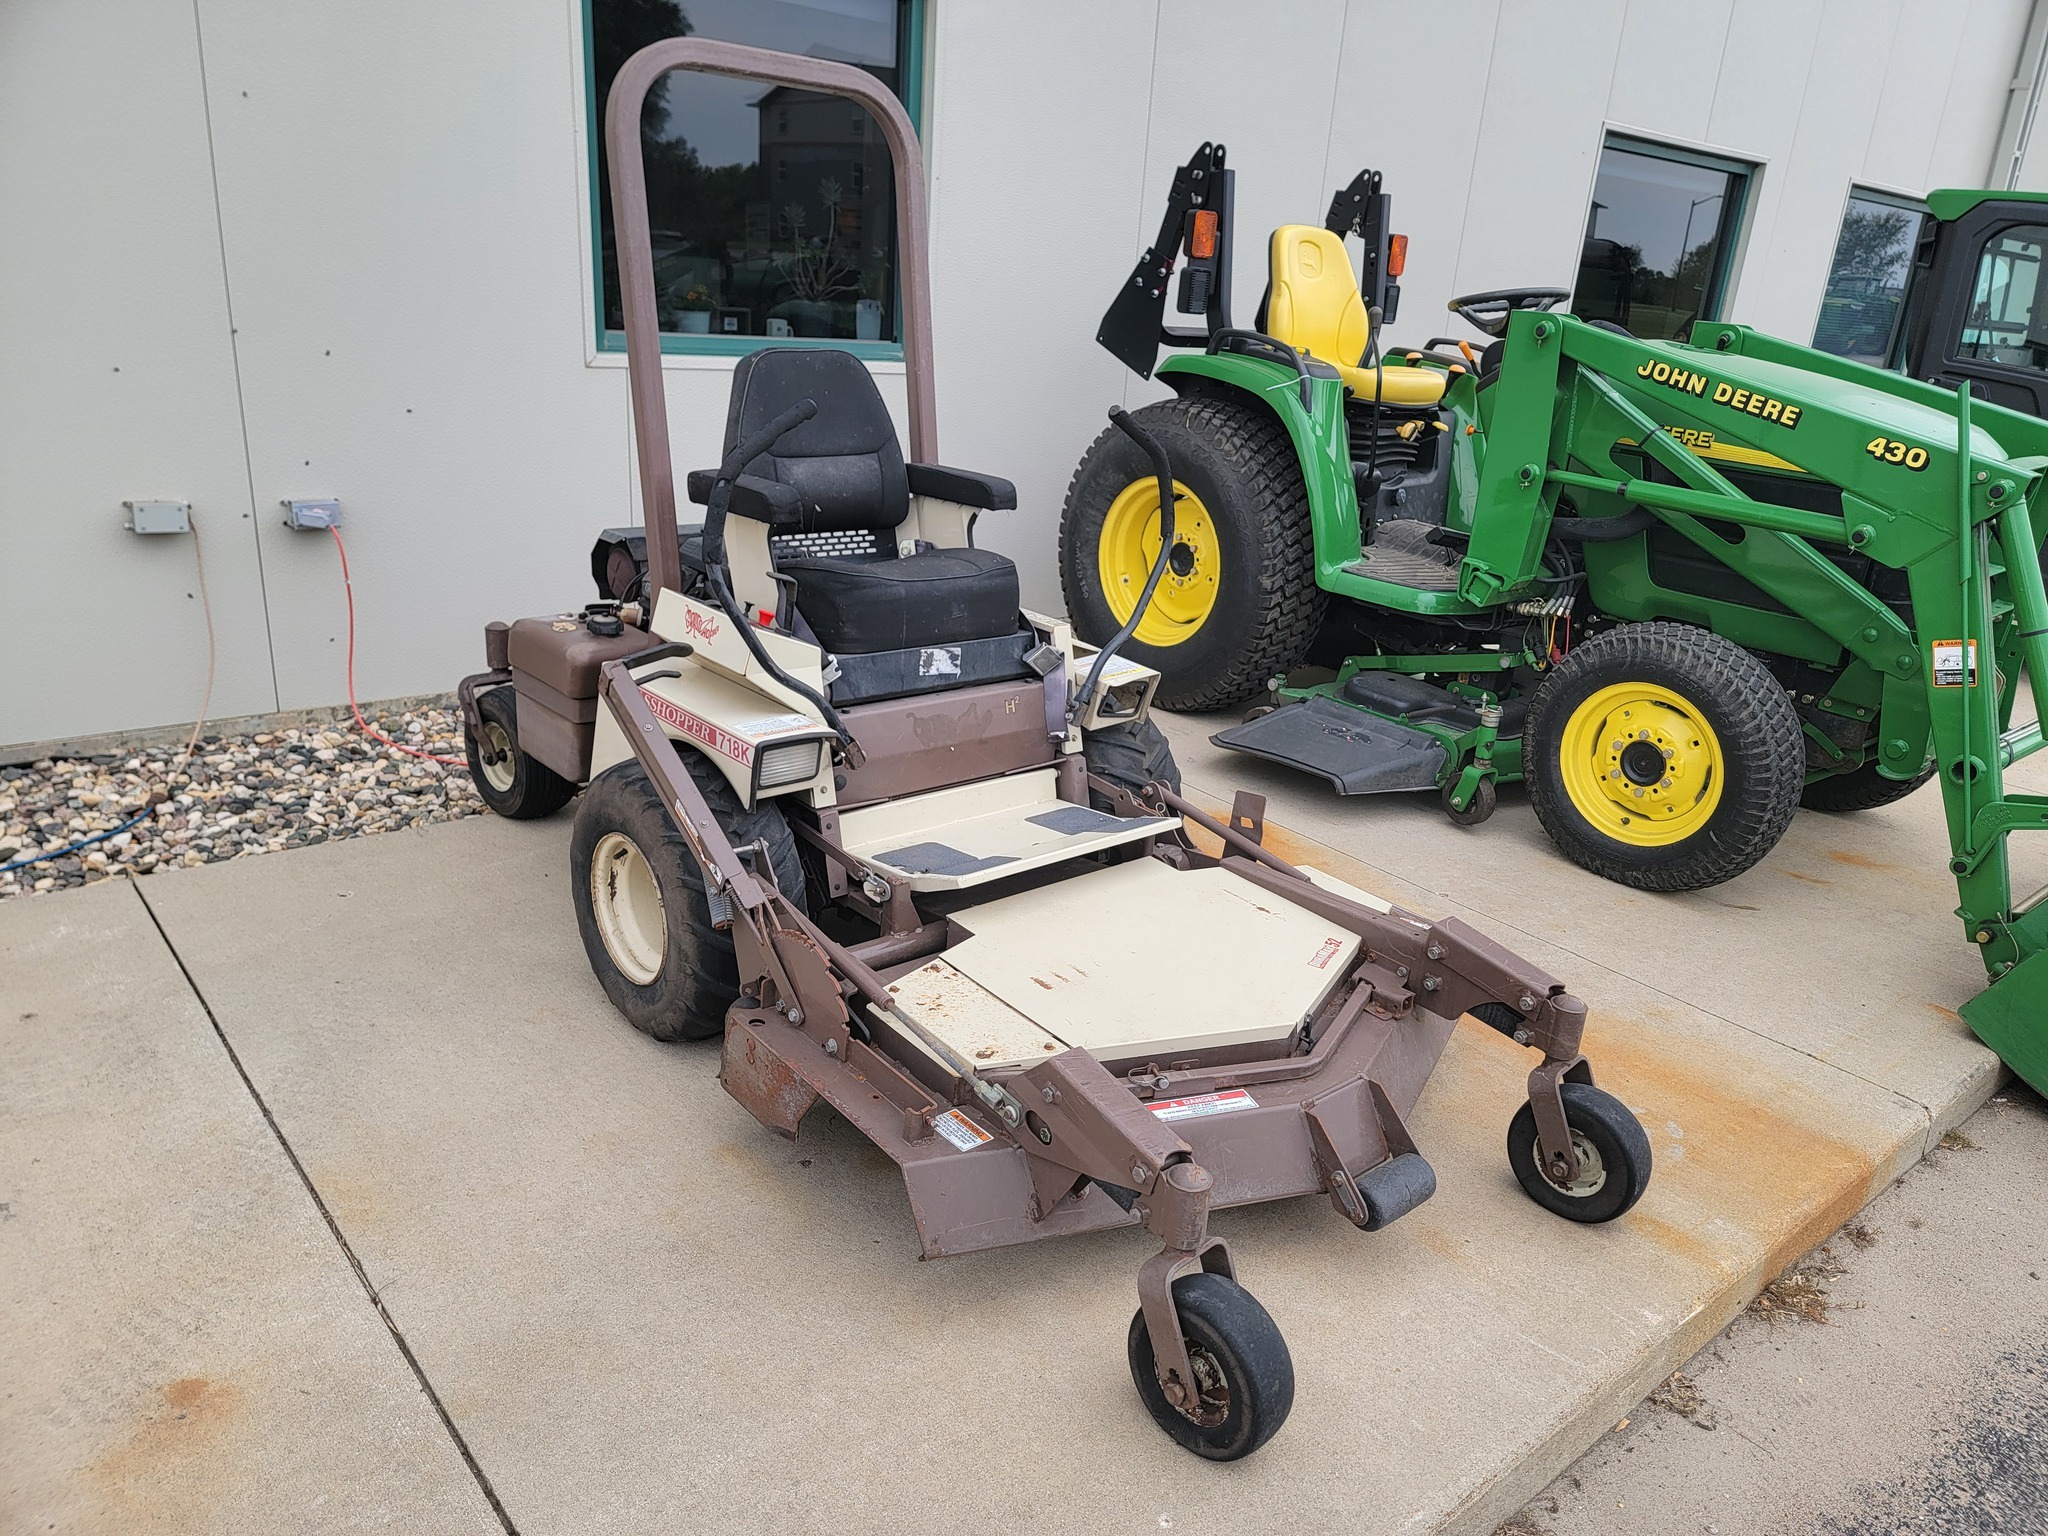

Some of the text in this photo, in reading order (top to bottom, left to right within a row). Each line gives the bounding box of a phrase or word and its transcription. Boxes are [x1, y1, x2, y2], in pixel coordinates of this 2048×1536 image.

[1636, 358, 1804, 429] JOHN DEERE
[1865, 437, 1931, 472] 430
[642, 691, 711, 742] SSHOPPER
[718, 733, 752, 765] 718K
[1325, 937, 1343, 948] 52
[1182, 1095, 1221, 1106] DANGER
[959, 1117, 984, 1137] WARNING
